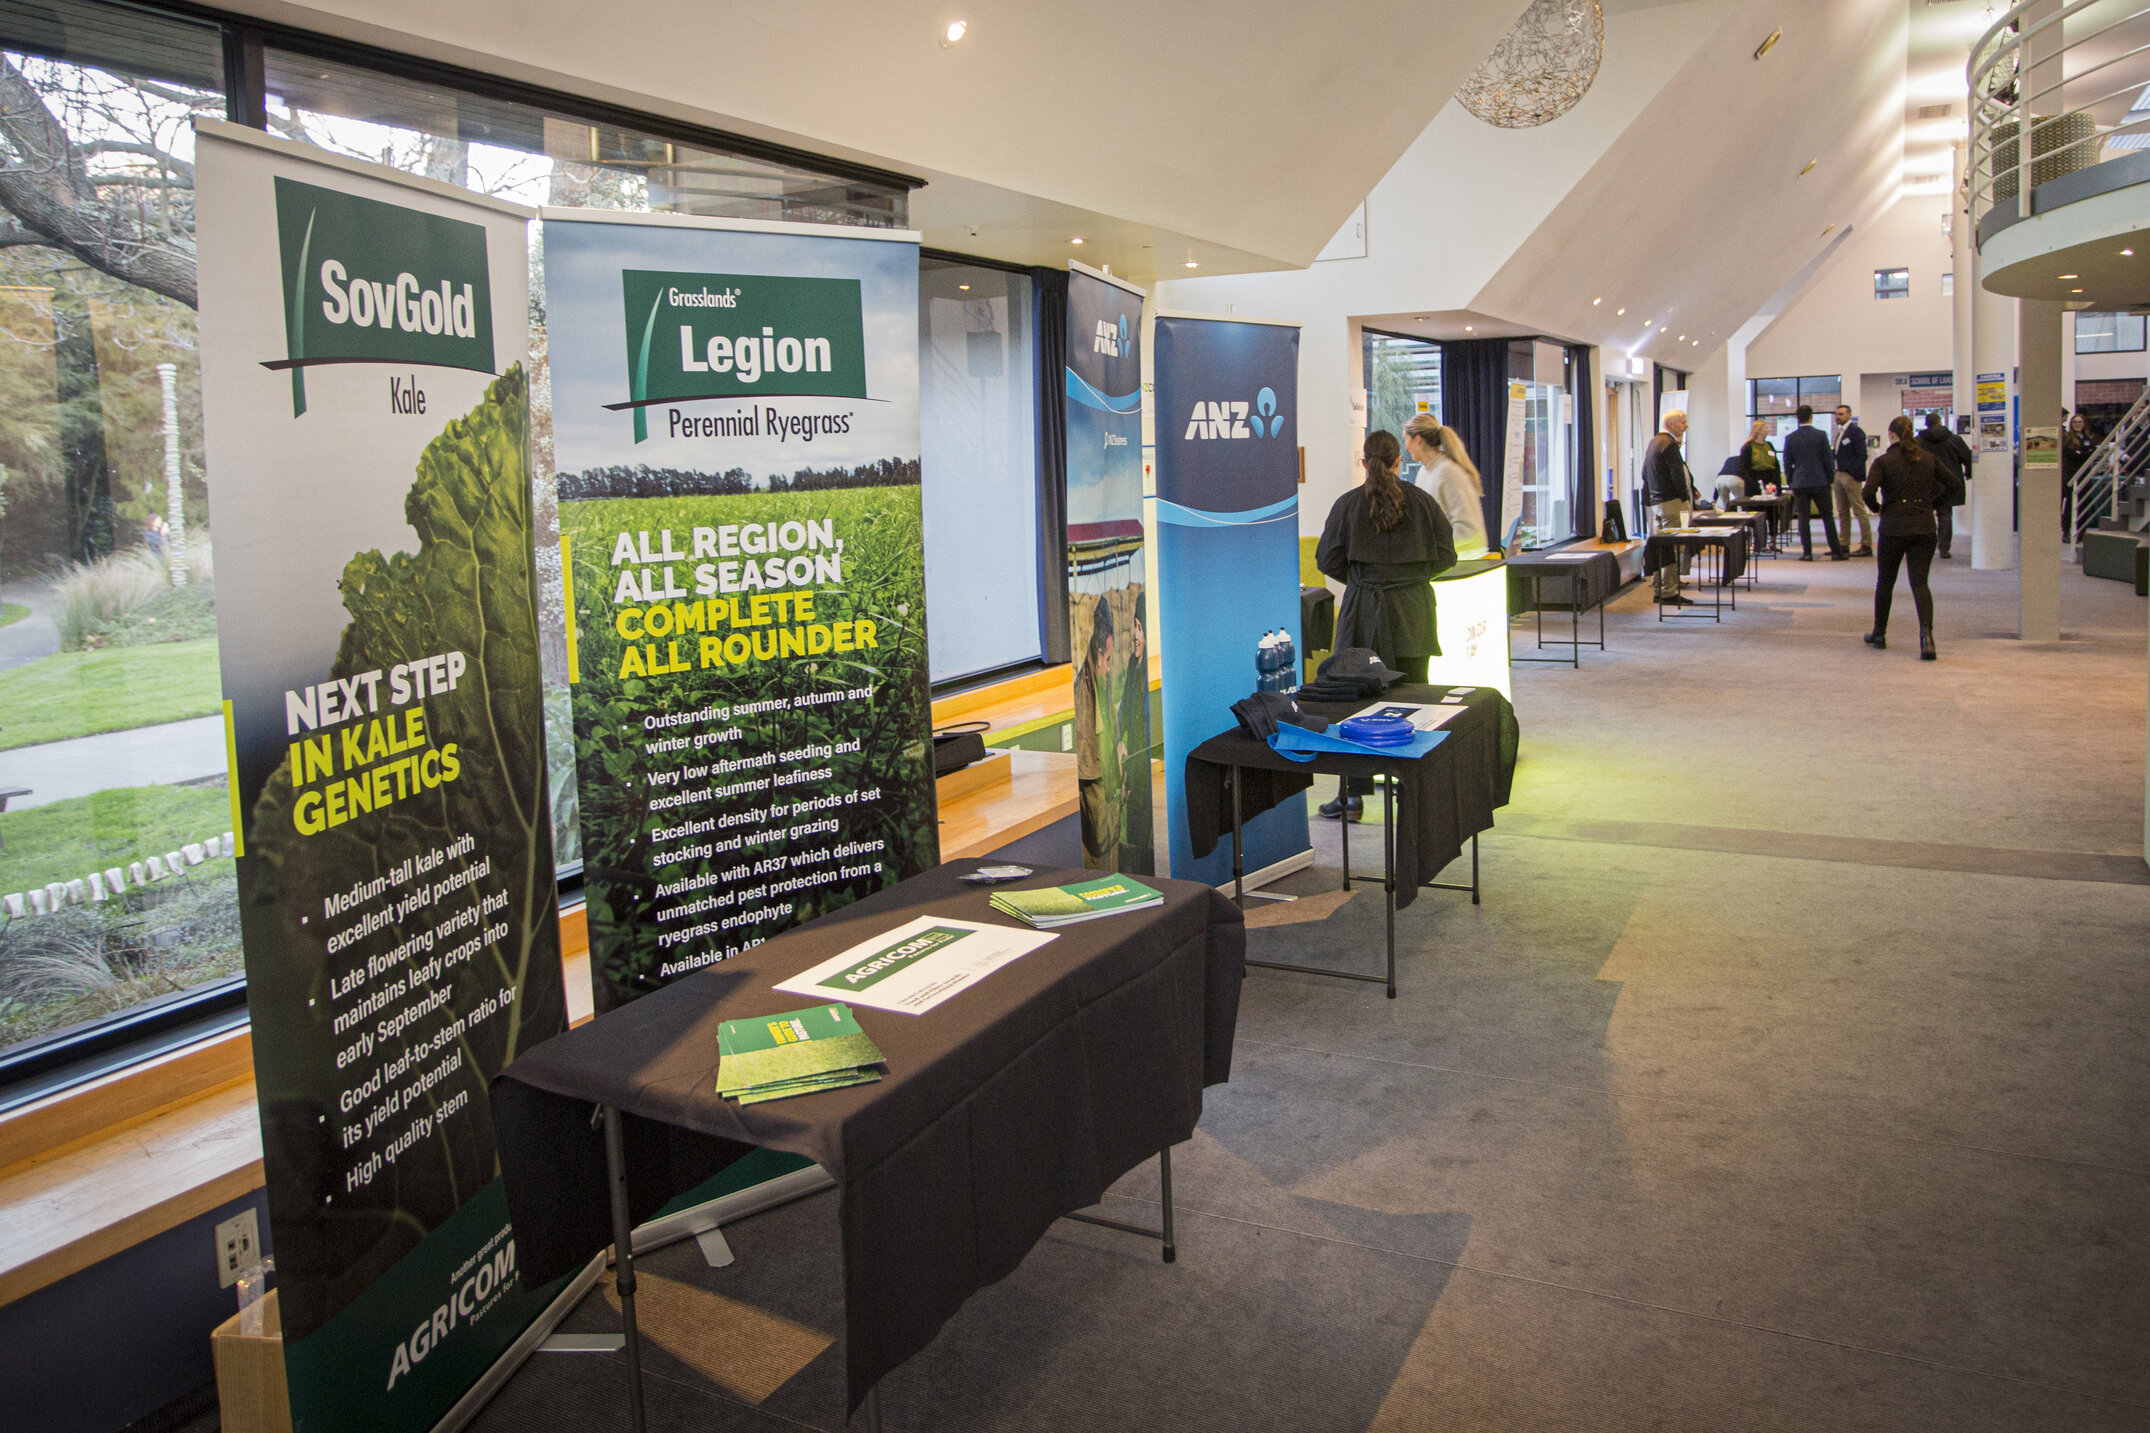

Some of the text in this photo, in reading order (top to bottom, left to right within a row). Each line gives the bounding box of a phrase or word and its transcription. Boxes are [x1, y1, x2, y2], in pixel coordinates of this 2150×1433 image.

[321, 259, 475, 338] SovGold
[680, 325, 832, 383] Legion
[1094, 319, 1118, 357] ANZ
[390, 374, 426, 415] Kale
[669, 405, 758, 438] Perennial
[1185, 401, 1250, 440] ANZ
[612, 519, 844, 566] ALL REGION,
[614, 552, 841, 603] ALL SEASON
[616, 590, 815, 641] COMPLETE
[619, 619, 879, 680] ALL ROUNDER
[285, 651, 467, 736] NEXT STEP
[644, 684, 873, 731] Outstanding summer, autumn and
[289, 706, 426, 788] IN KALE
[645, 726, 743, 755] winter growth
[648, 738, 861, 788] Very low aftermath seeding and
[293, 743, 460, 836] GENETICS
[649, 766, 833, 811] excellent summer leafiness
[651, 787, 881, 843] Excellent density for periods of set
[653, 818, 839, 867] stocking and winter grazing
[654, 838, 885, 899] Available with AR37 which delivers
[324, 833, 476, 919] Medium-tall kale with
[657, 896, 735, 923] unmatched
[737, 885, 767, 906] pest
[770, 870, 838, 896] protection
[840, 862, 871, 880] from
[327, 856, 491, 954] excellent yield potential
[658, 903, 793, 947] ryegrass endophyte
[331, 889, 509, 1000] Late flowering variety that
[660, 949, 723, 977] Available
[725, 945, 739, 959] in
[845, 938, 933, 984] AGRICOM
[333, 922, 509, 1035] maintains leafy crops into
[336, 984, 452, 1069] early September
[340, 985, 517, 1112] Good leaf-to-stem ratio for
[343, 1048, 462, 1148] its yield potential
[346, 1089, 468, 1192] High quality stem
[451, 1255, 477, 1285] Another
[477, 1238, 494, 1262] great
[386, 1239, 516, 1392] AGRICOM
[470, 1291, 502, 1326] Pastures
[503, 1279, 514, 1293] for
